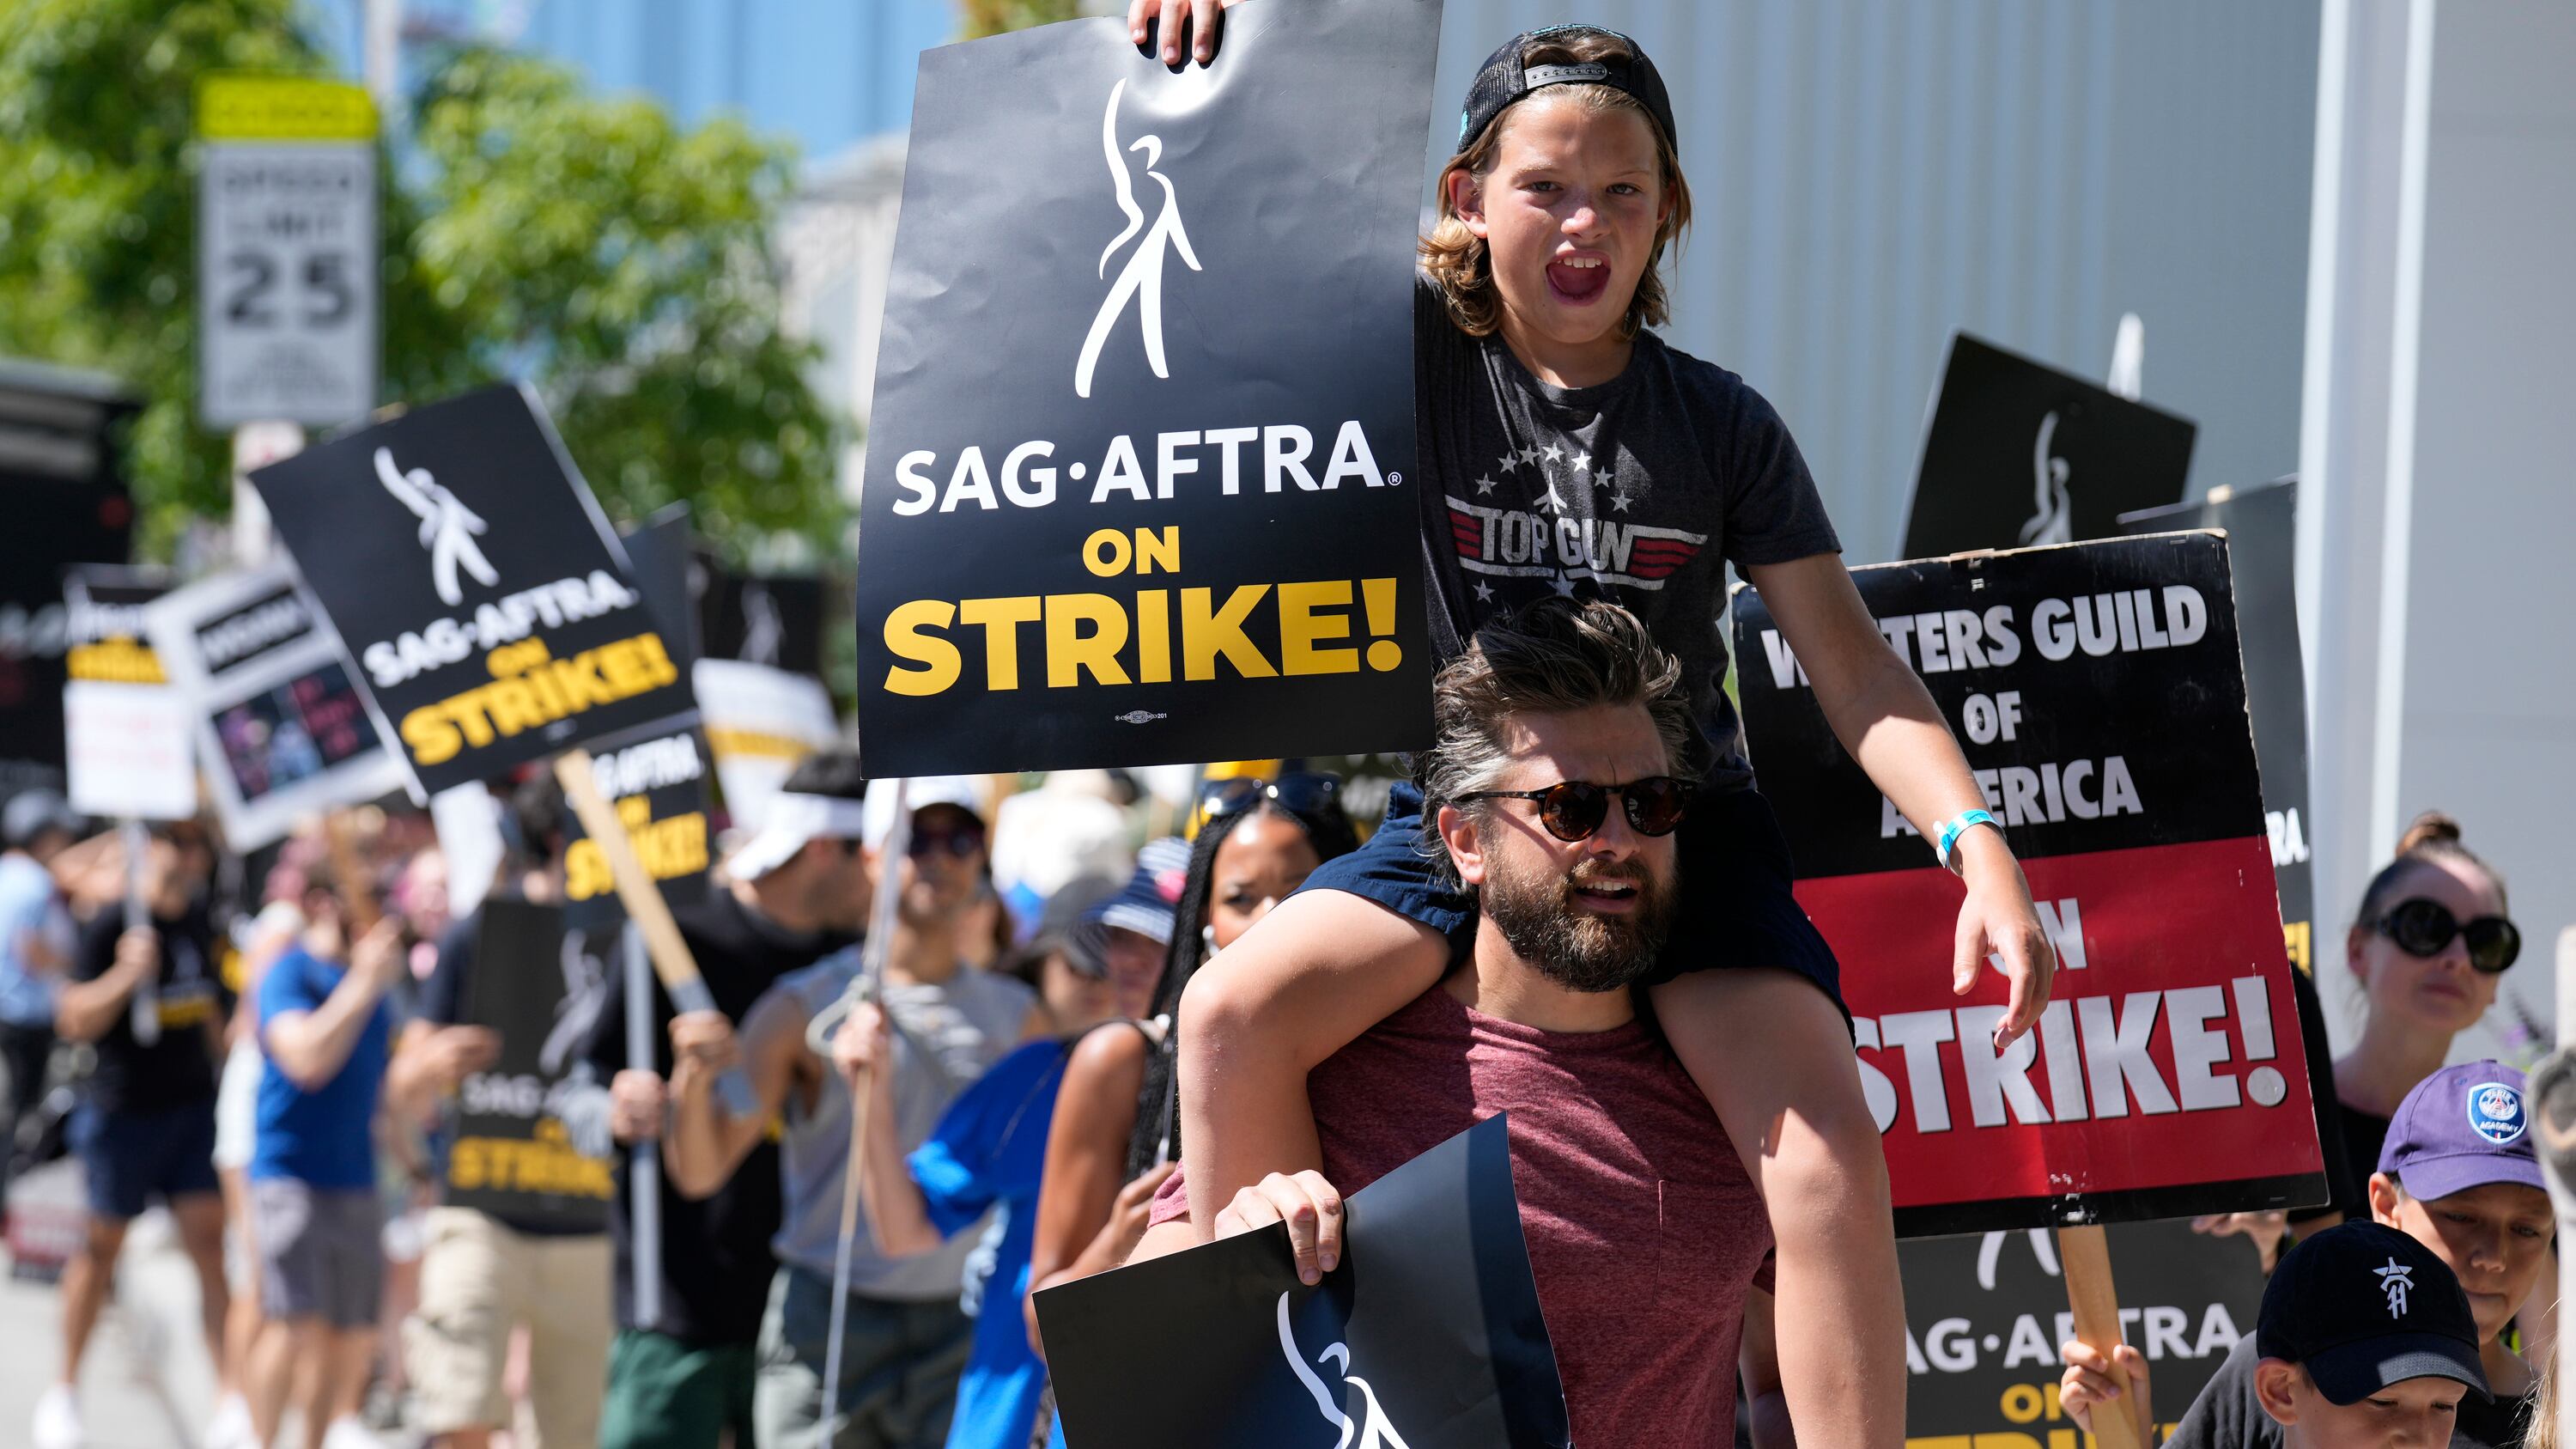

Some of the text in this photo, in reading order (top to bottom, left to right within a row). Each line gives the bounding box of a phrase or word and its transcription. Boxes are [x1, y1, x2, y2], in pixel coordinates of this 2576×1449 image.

[225, 253, 355, 330] 25
[1082, 525, 1181, 578] ON
[1479, 508, 1635, 572] TOP GUN
[486, 636, 551, 680] ON
[883, 577, 1403, 697] STRIKE!
[1760, 584, 2208, 689] WTERS GUILD
[400, 632, 678, 766] STRIKE!
[1963, 691, 2022, 746] OF
[1880, 756, 2144, 838] AERICA
